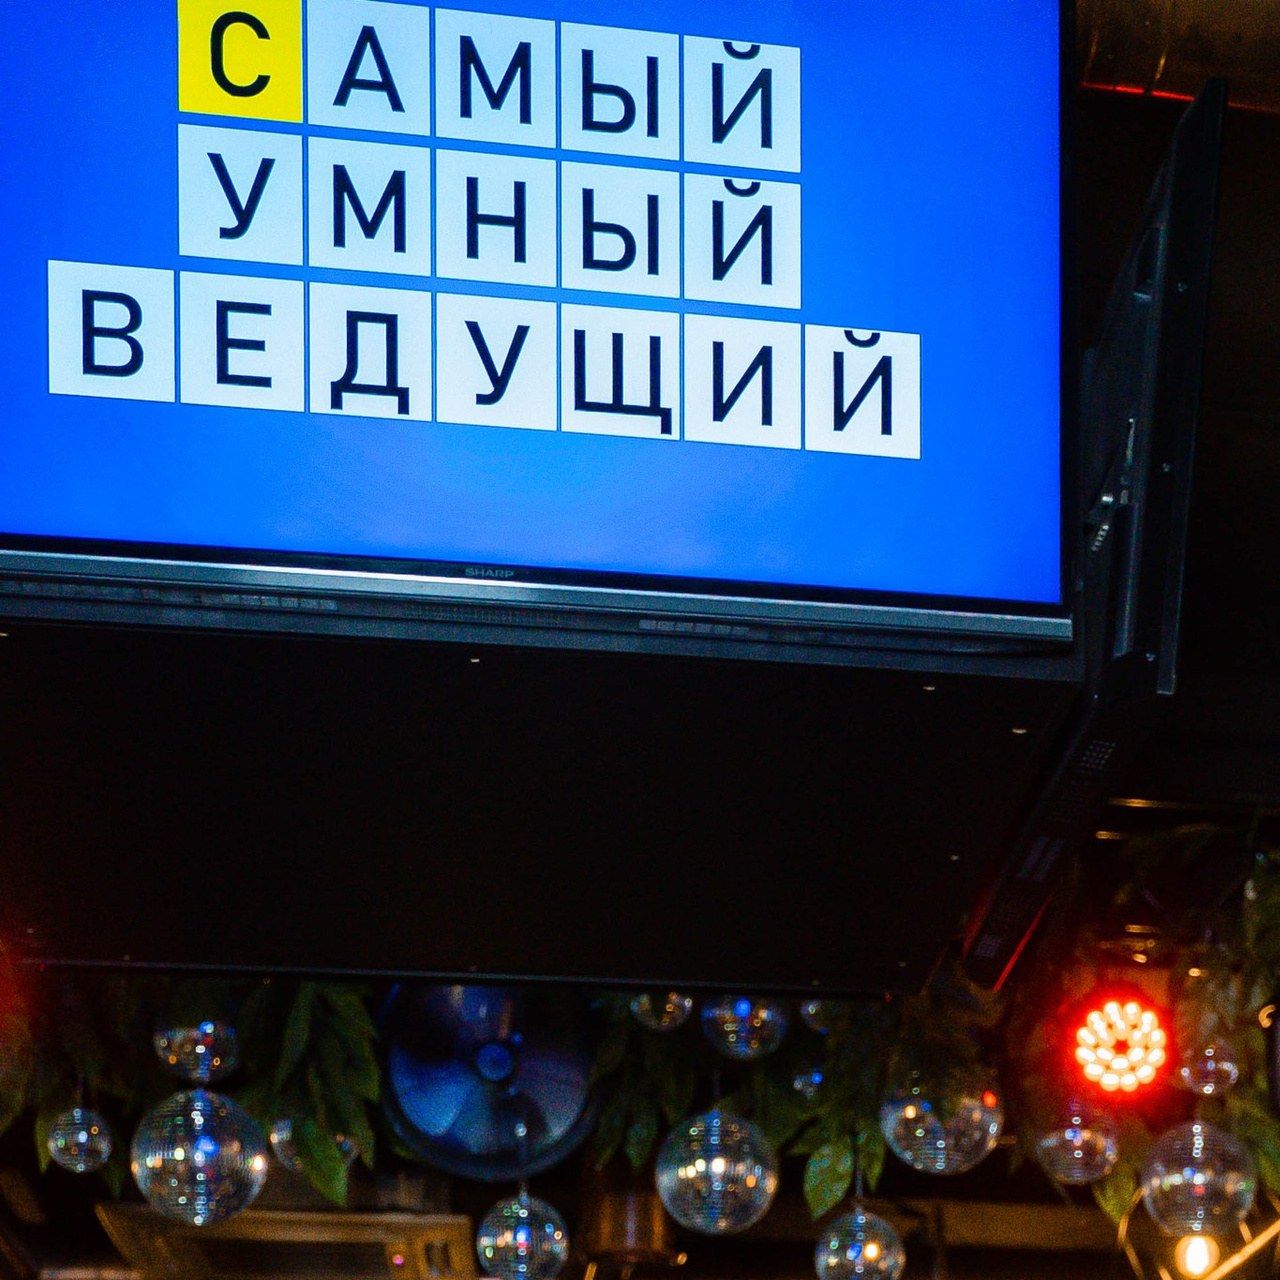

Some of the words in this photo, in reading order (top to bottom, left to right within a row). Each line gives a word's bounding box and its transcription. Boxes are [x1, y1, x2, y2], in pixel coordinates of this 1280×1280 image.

[210, 11, 772, 149] САМЫЙ
[207, 152, 772, 286] УМНЫЙ
[82, 289, 892, 435] ВЕДУЩИЙ
[465, 567, 514, 578] SHARP
